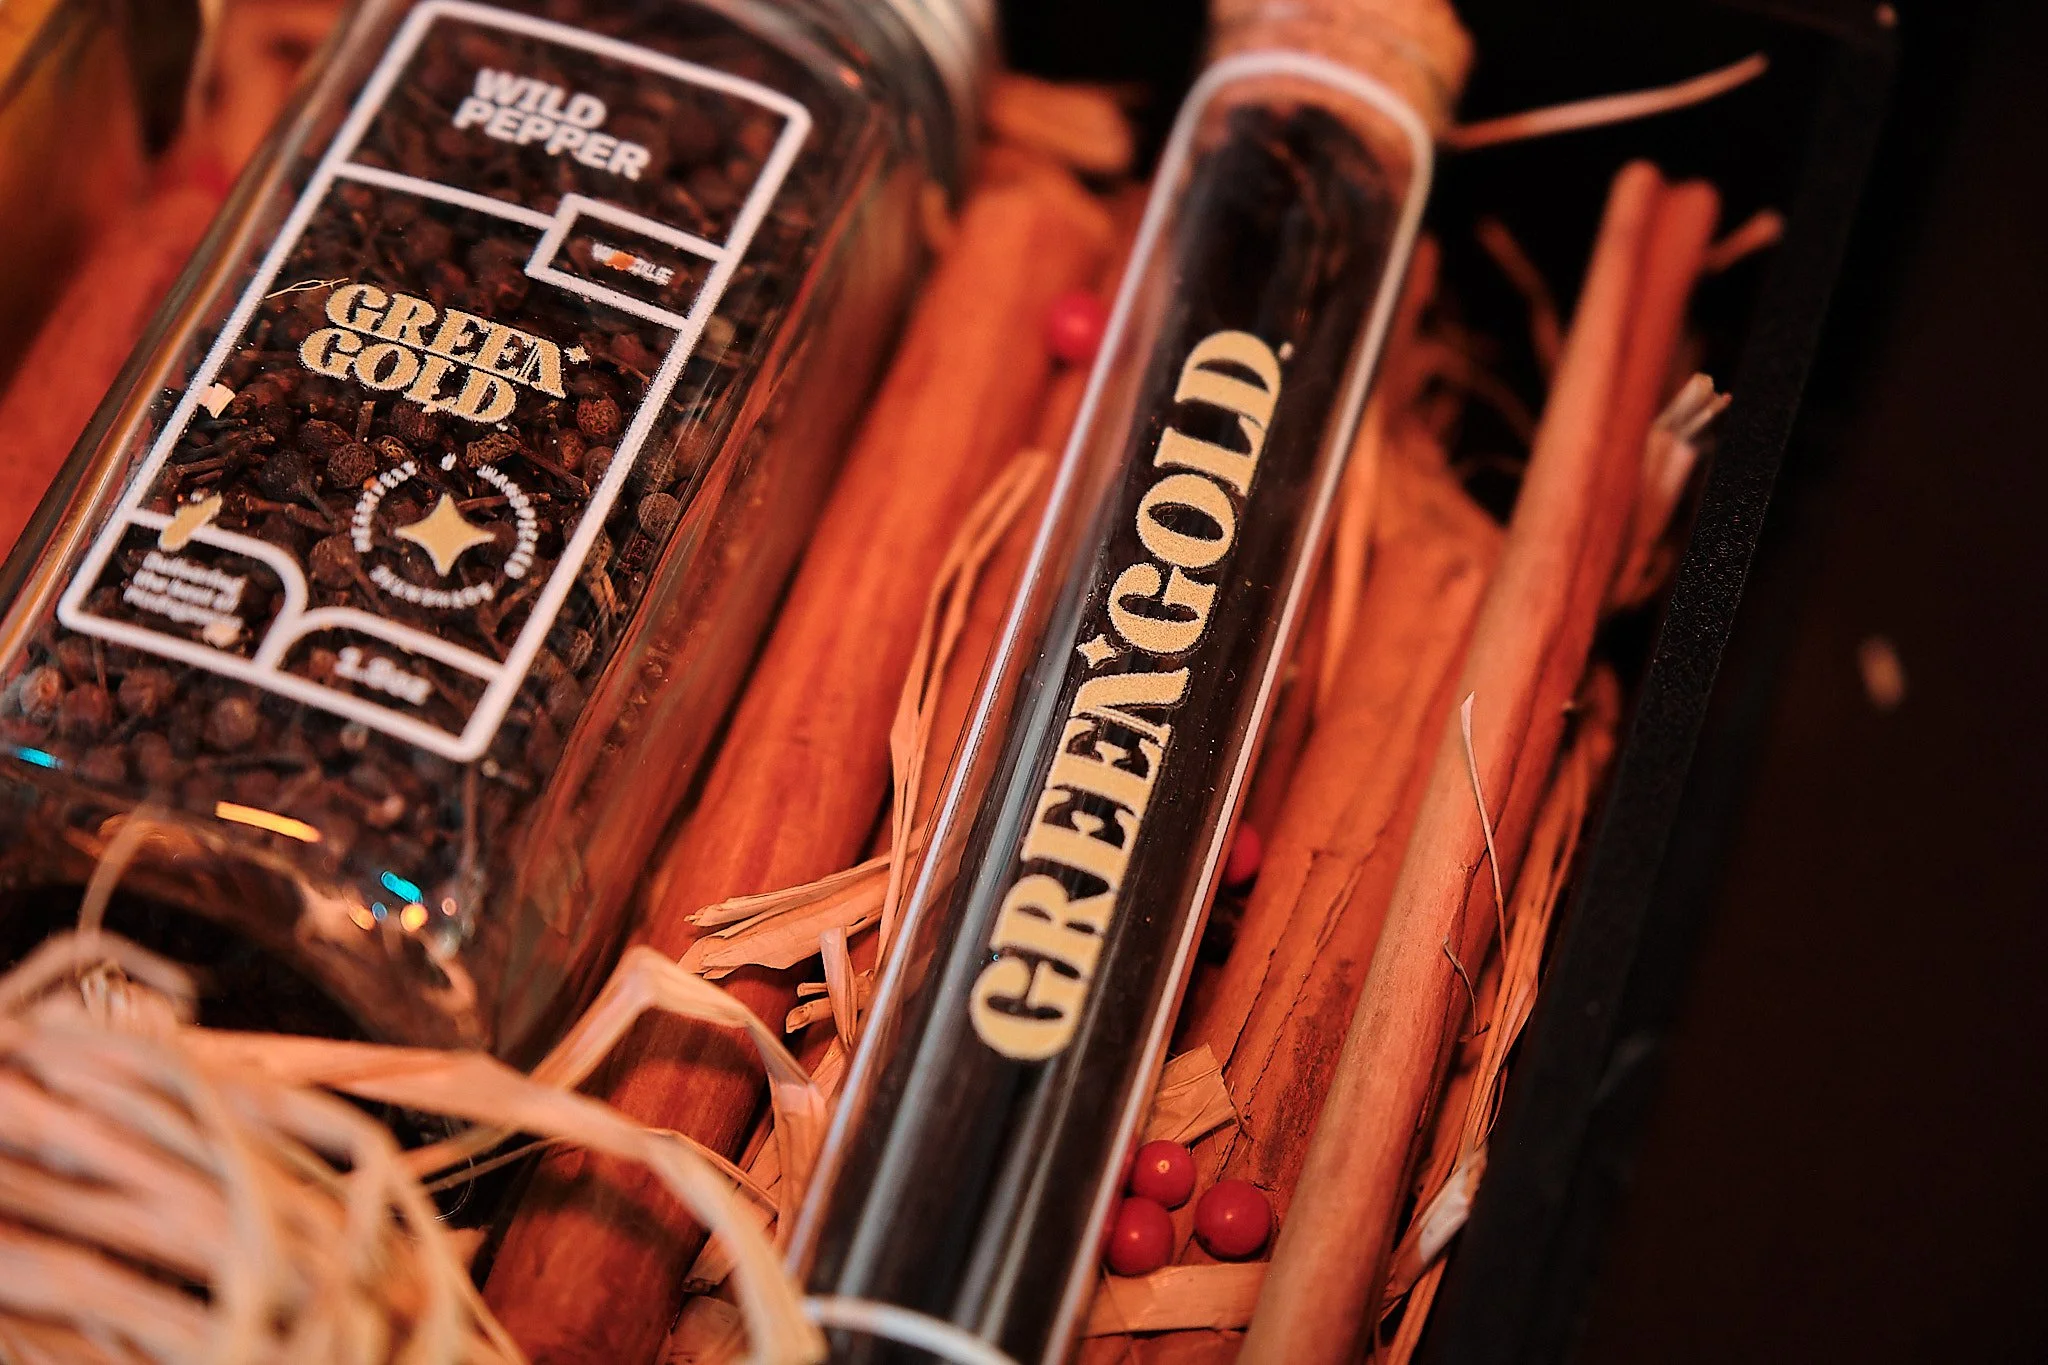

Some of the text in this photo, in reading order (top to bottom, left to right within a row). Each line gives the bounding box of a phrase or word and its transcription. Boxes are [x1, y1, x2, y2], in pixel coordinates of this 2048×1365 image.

[452, 96, 653, 182] PEPPER
[473, 67, 607, 130] WILD
[325, 282, 567, 399] GREEN
[969, 668, 1190, 1062] GREEN
